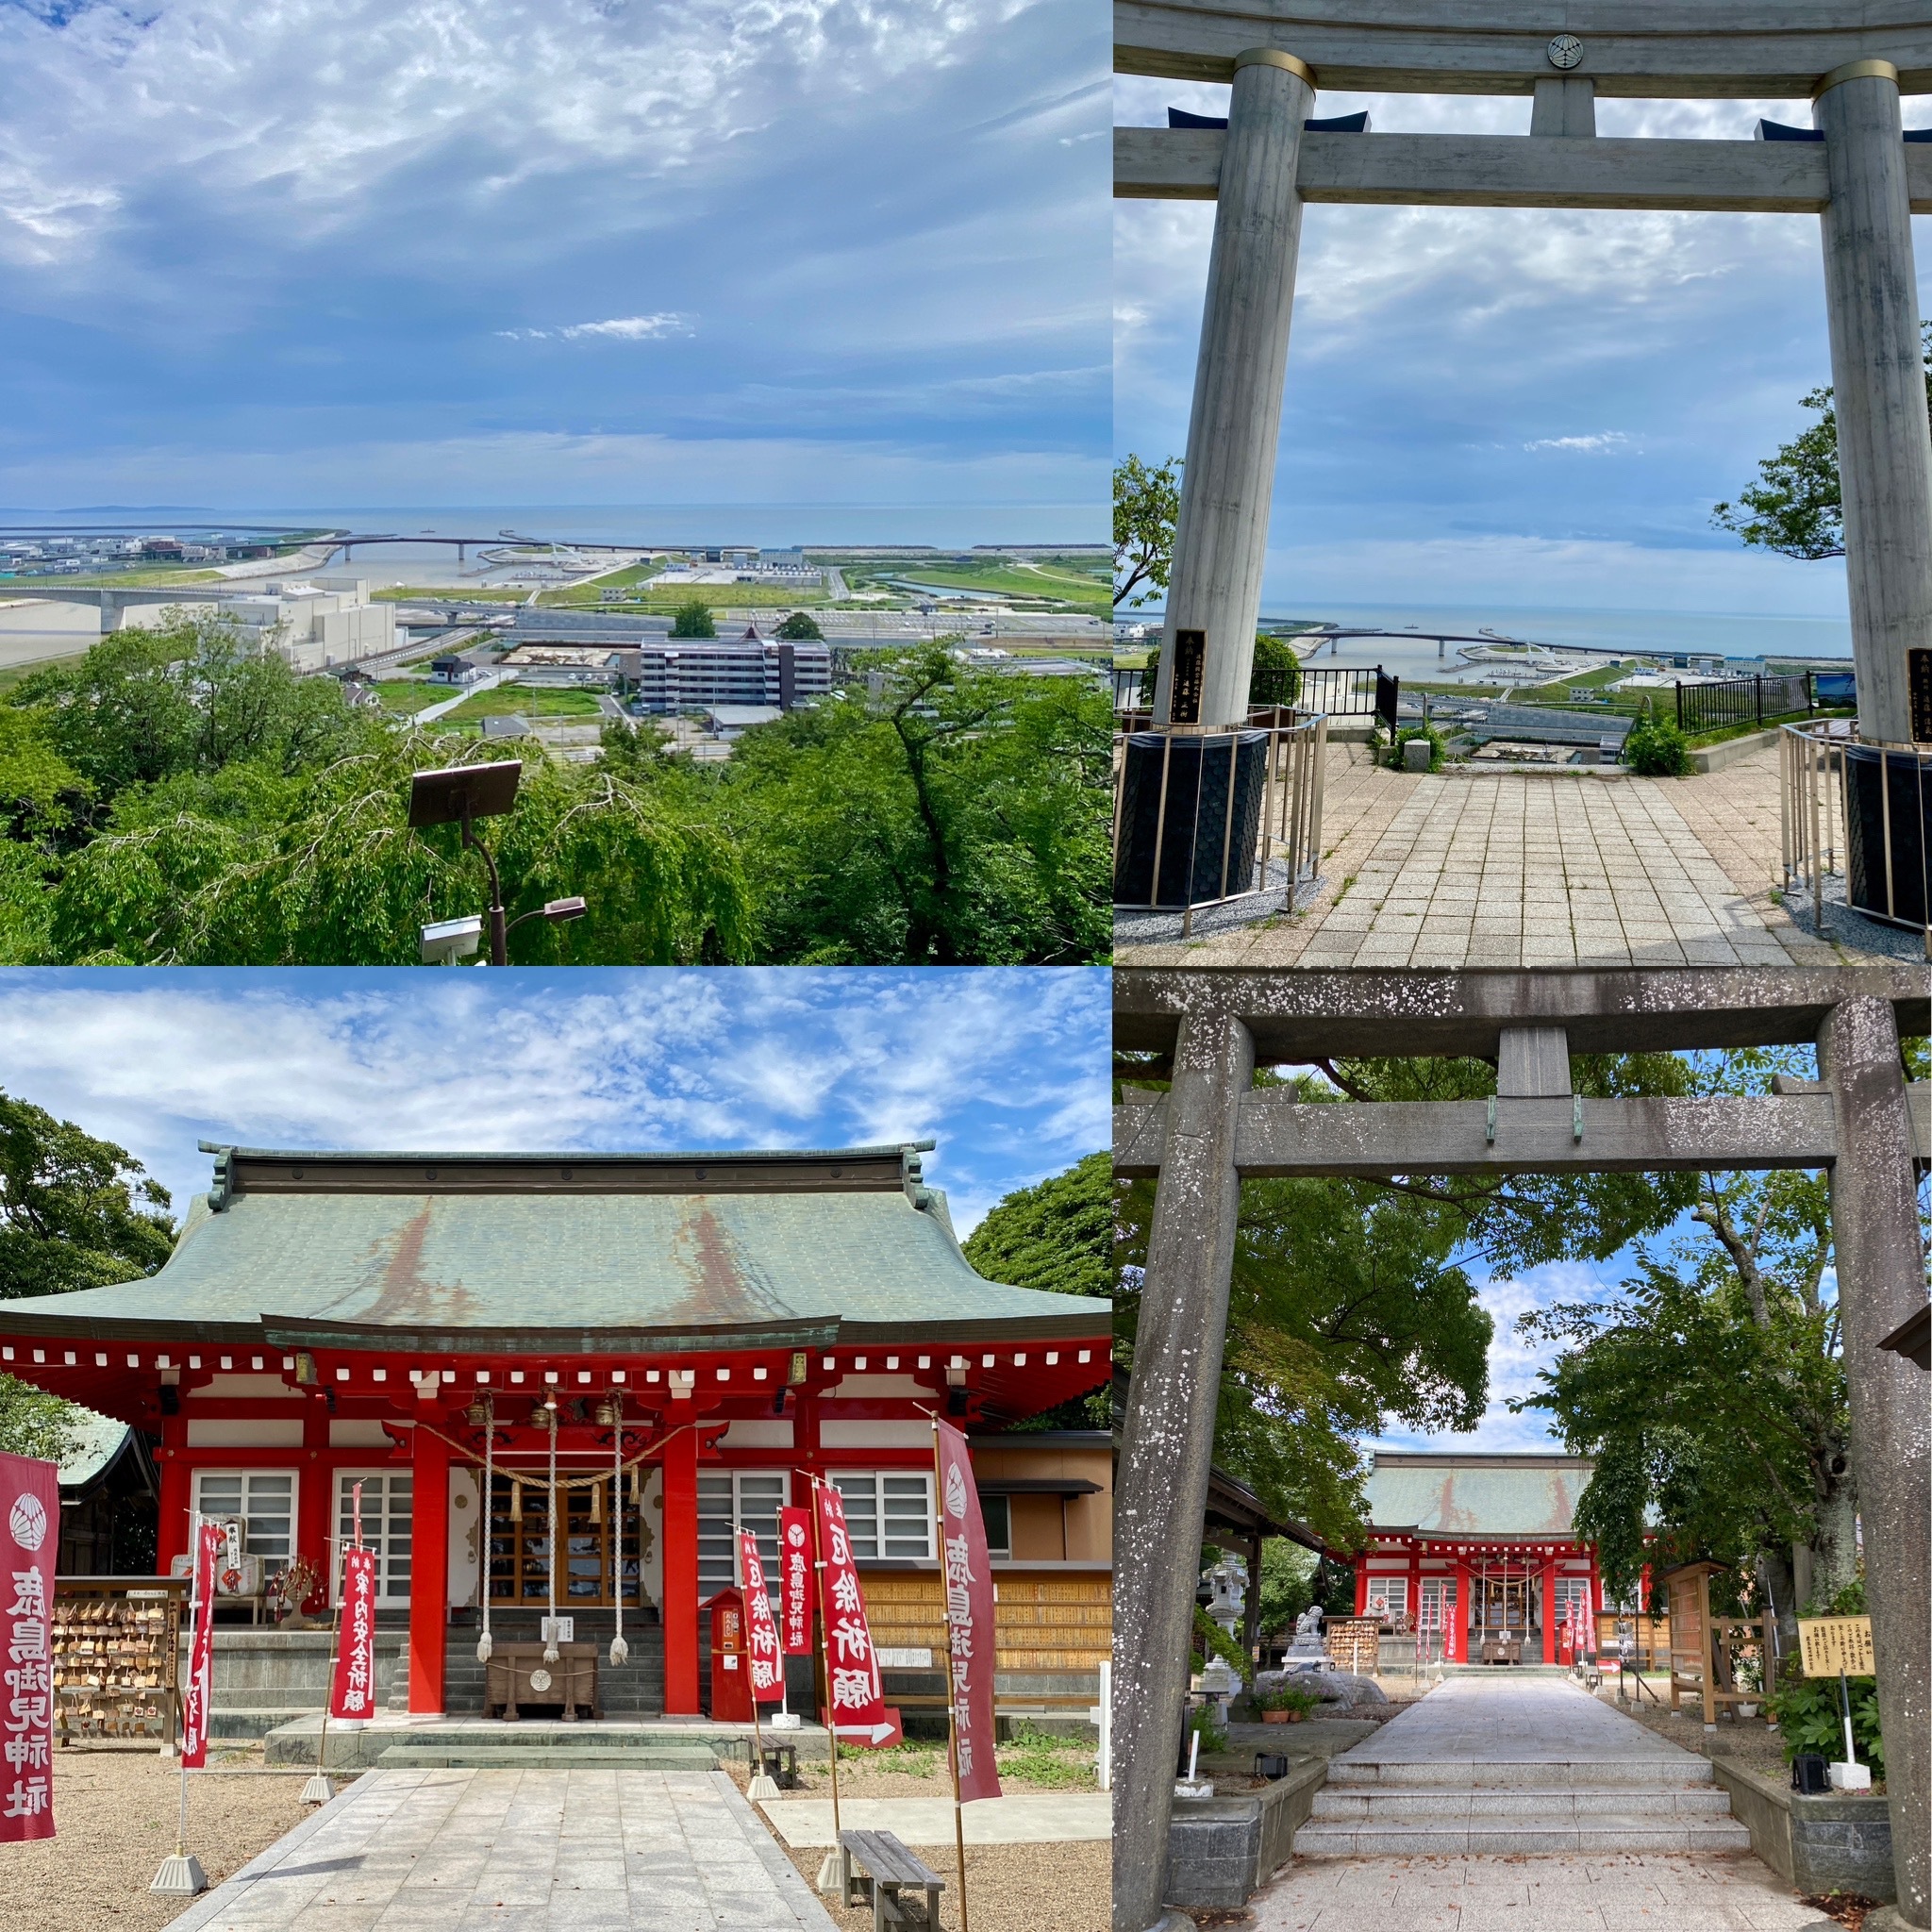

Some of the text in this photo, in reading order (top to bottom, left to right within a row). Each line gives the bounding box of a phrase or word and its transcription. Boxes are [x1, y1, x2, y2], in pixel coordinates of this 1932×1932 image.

[1185, 636, 1193, 655] 奉納
[1921, 654, 1930, 673] 奉納
[1863, 1630, 1872, 1655] お願い
